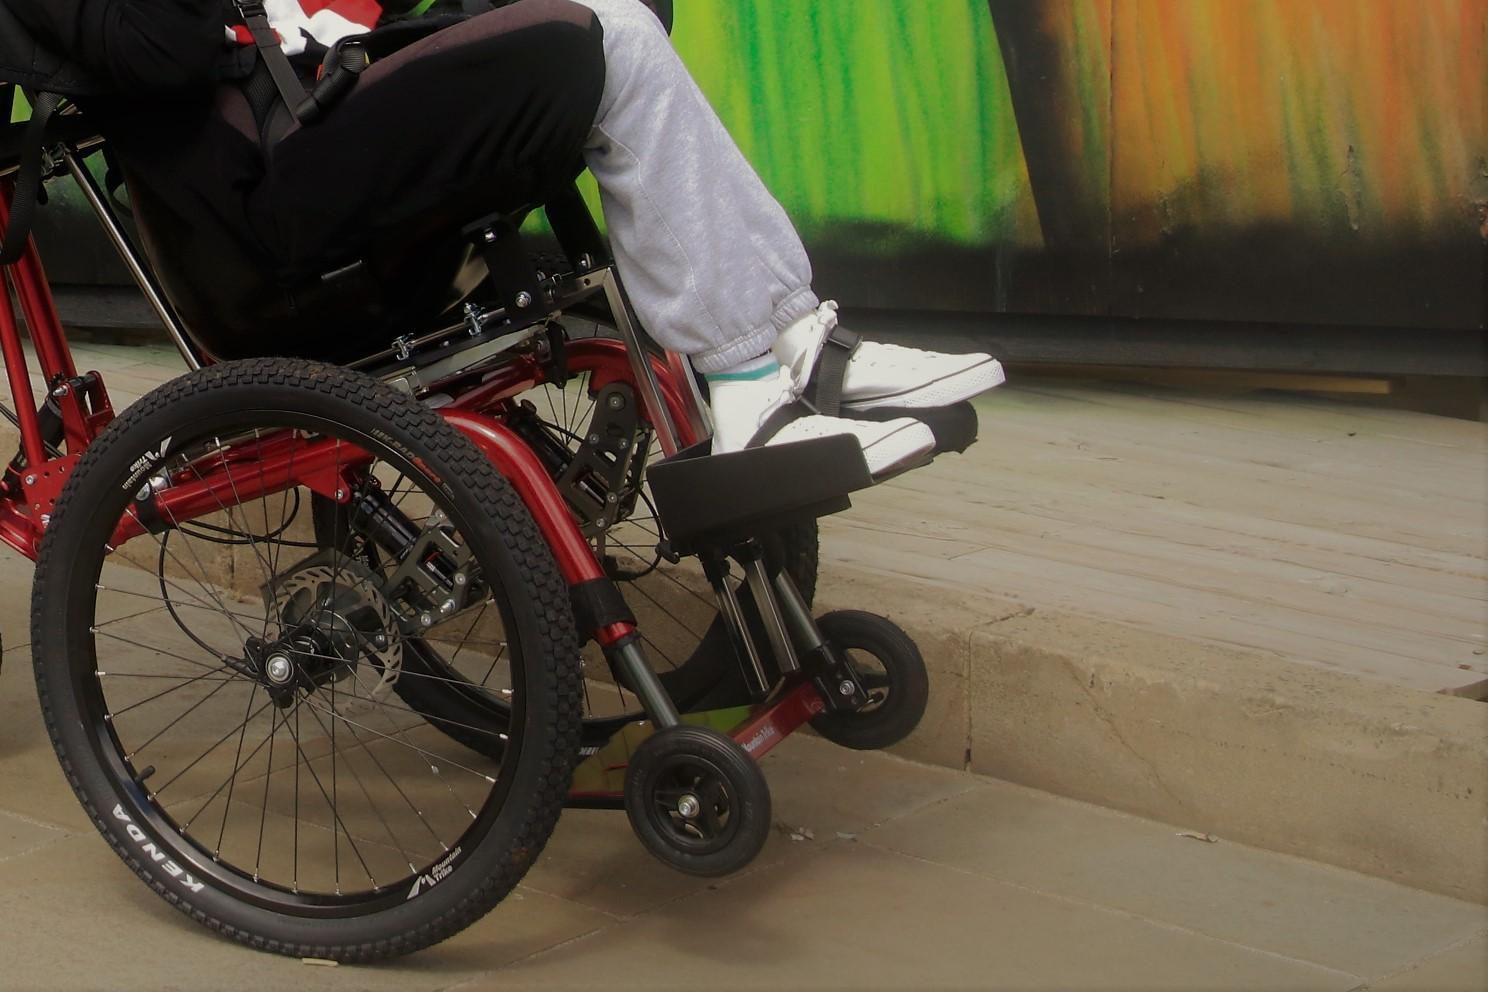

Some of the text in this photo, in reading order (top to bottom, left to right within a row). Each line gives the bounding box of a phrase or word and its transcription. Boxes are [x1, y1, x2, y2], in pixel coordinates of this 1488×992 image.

[122, 460, 153, 490] Mountain
[129, 455, 149, 473] Trike
[112, 803, 205, 893] KENDA
[432, 846, 462, 875] Mountain
[434, 865, 453, 882] Trike
